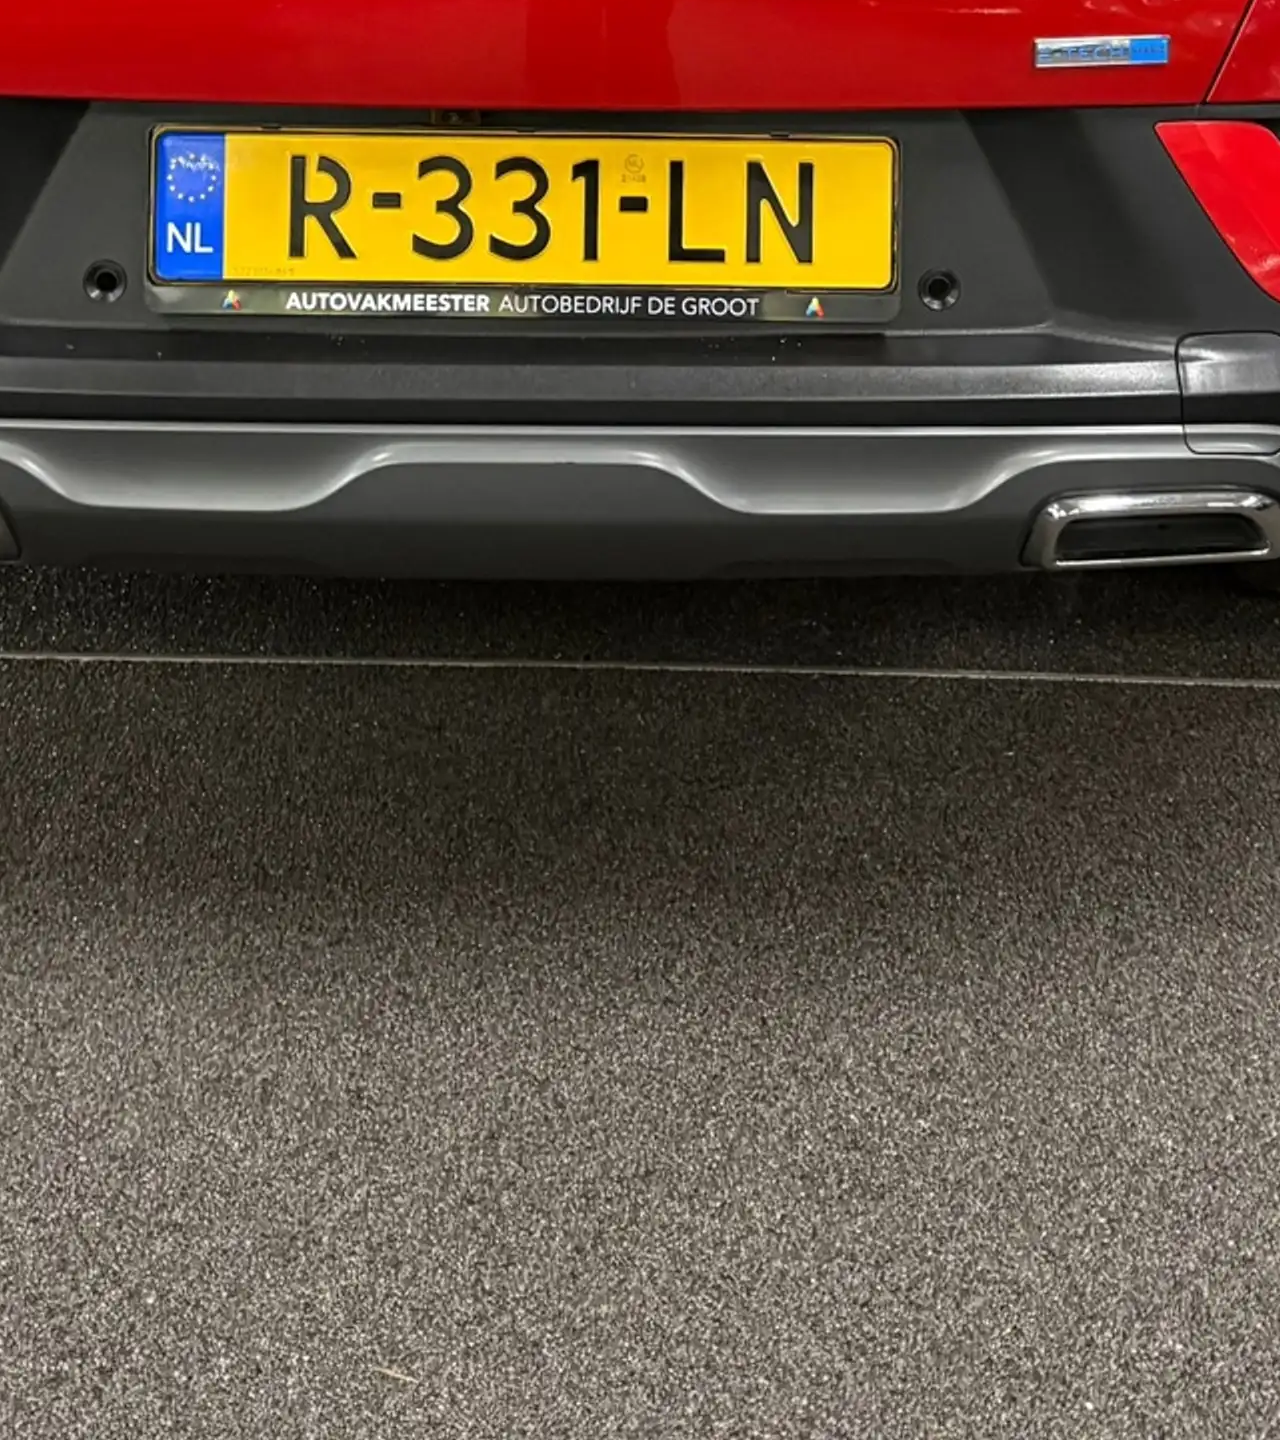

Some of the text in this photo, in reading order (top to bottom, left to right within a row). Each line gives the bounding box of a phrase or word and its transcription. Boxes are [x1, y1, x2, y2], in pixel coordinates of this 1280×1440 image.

[287, 154, 816, 265] R-331-LN
[166, 221, 215, 254] NL
[286, 291, 760, 317] AUTOVAKMEESTER AUTOBEDRIJF DE GROOT
